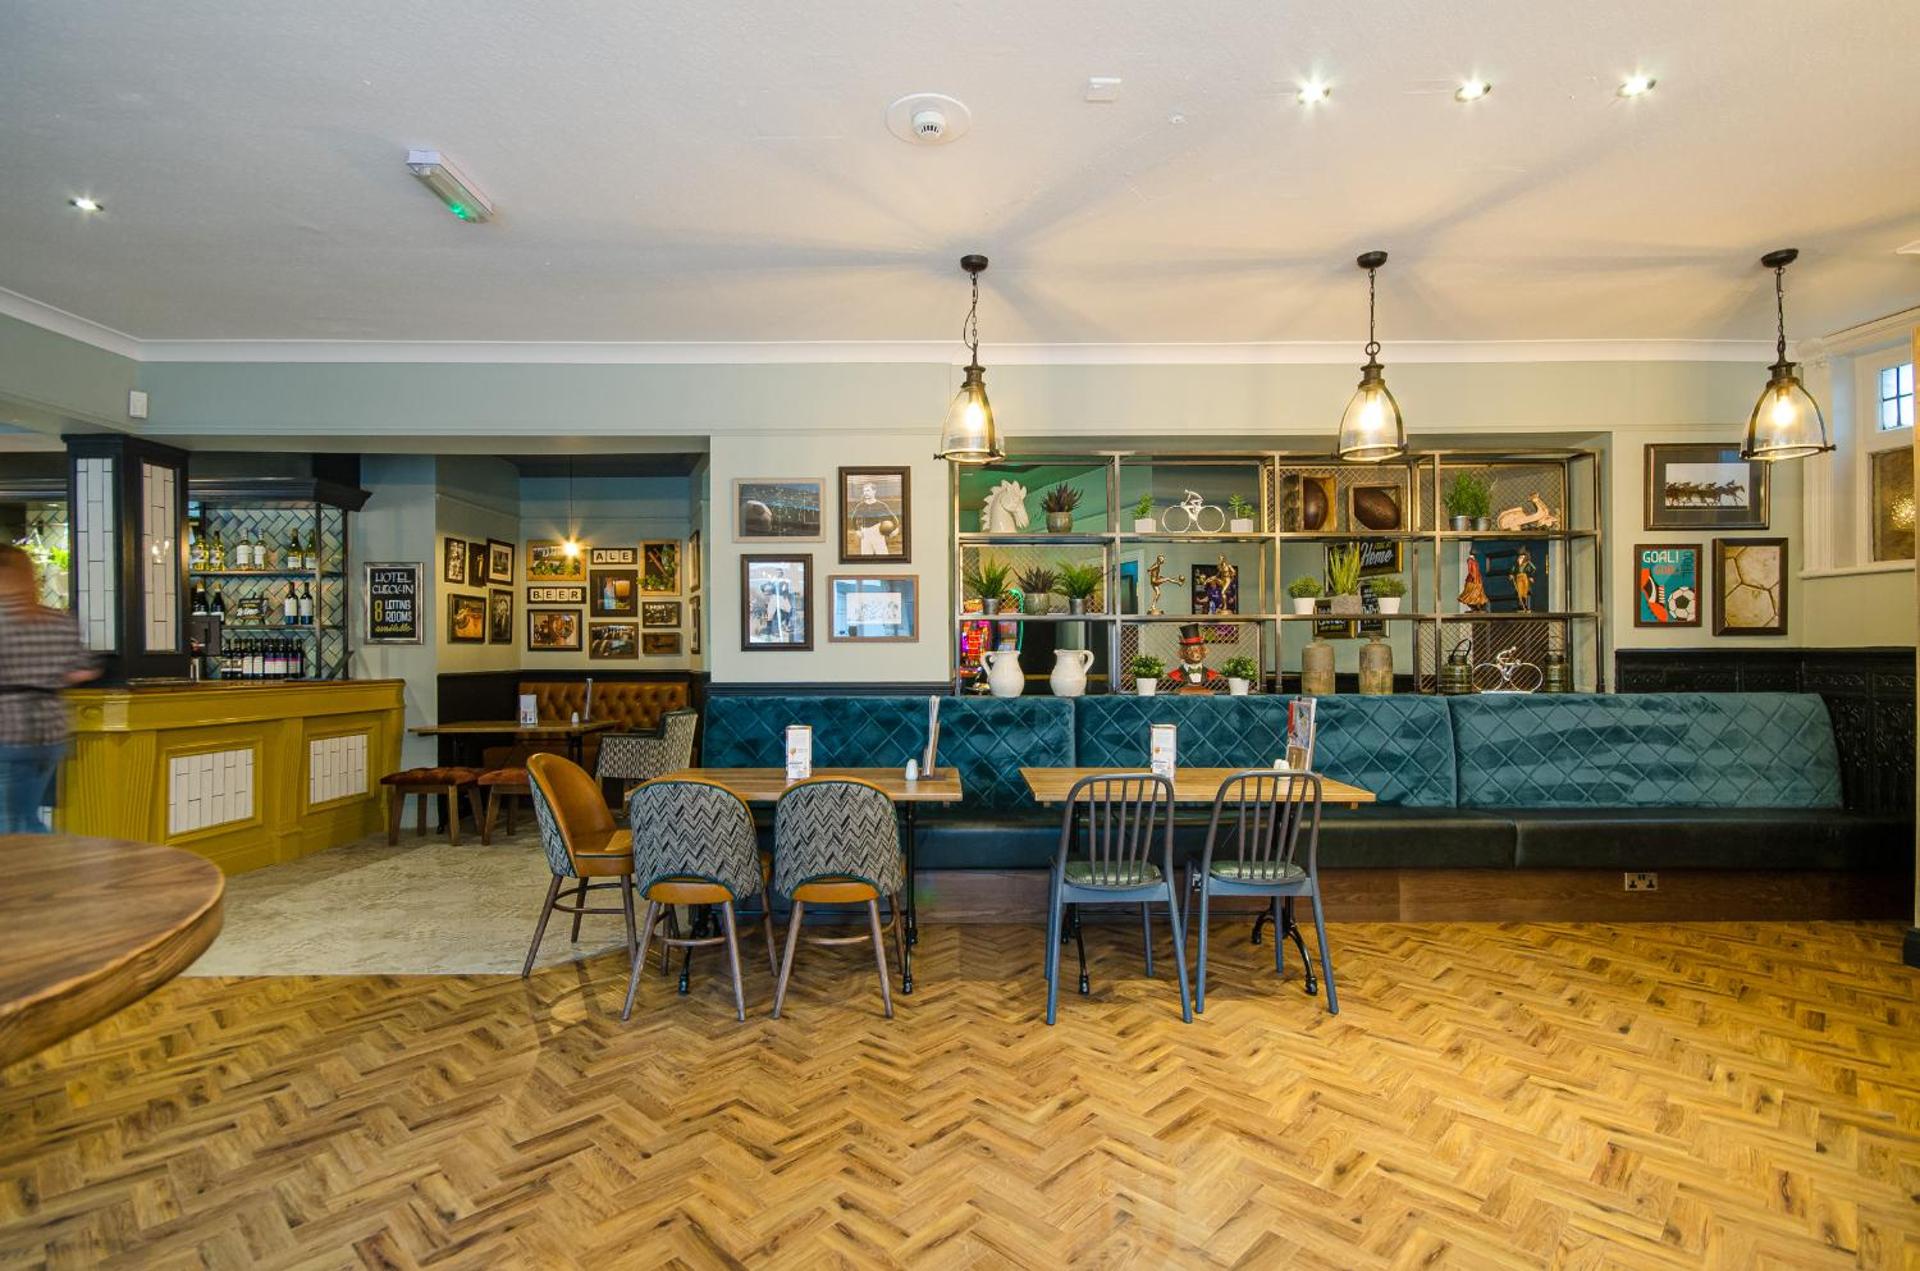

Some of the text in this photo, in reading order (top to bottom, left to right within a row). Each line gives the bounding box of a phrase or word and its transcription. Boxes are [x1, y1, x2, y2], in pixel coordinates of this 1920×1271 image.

[595, 552, 630, 560] ALE
[1360, 542, 1393, 567] Home
[375, 572, 412, 583] HOTEL
[372, 584, 414, 594] CHECK-IN
[533, 590, 579, 599] BEER
[375, 599, 411, 622] 8 LETTING
[385, 611, 412, 622] ROOMS
